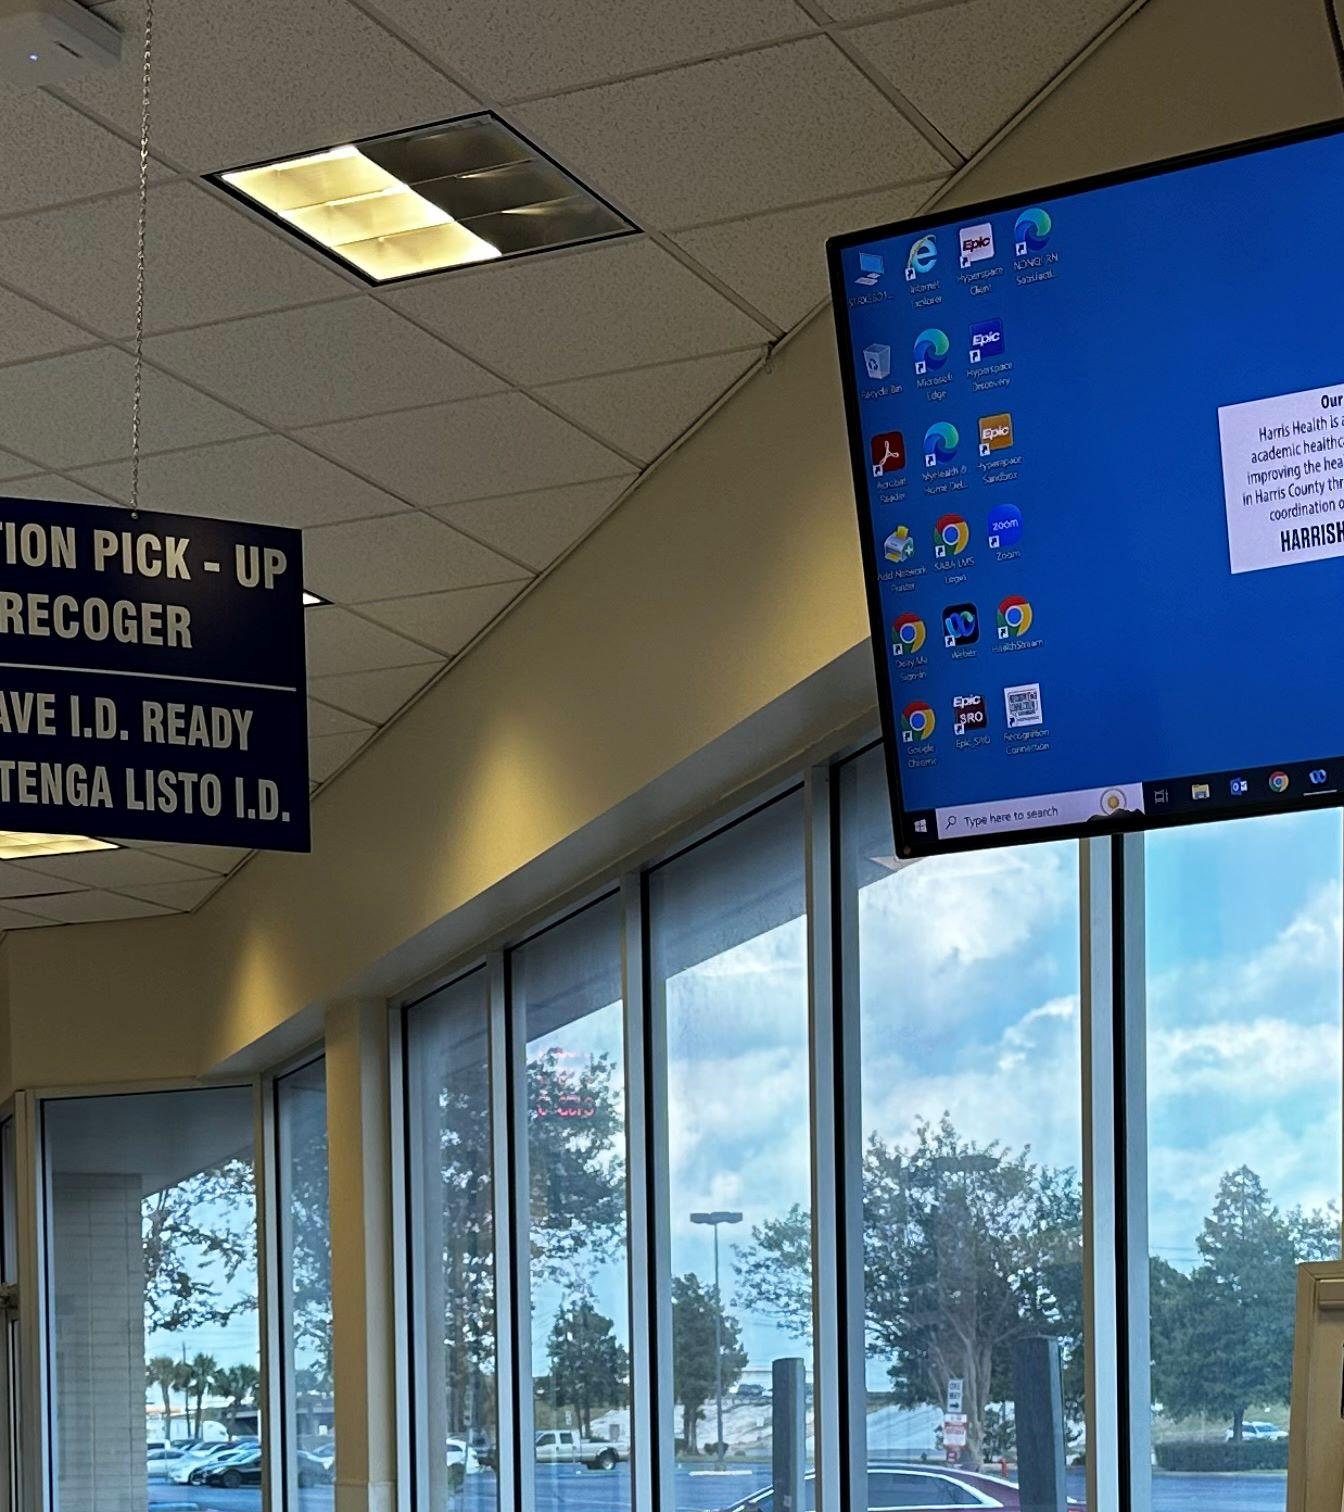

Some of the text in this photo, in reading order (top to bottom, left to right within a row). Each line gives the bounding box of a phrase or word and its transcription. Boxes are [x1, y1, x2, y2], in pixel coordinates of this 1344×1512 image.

[962, 236, 991, 252] Epic
[972, 330, 1001, 347] Epic
[1320, 394, 1344, 409] Our
[982, 425, 1010, 441] Epic
[1258, 424, 1291, 442] Harris
[1292, 416, 1328, 435] Health
[1329, 414, 1339, 429] is
[1251, 444, 1301, 464] academic
[1247, 465, 1301, 485] improving
[1303, 459, 1322, 475] the
[1242, 493, 1253, 506] in
[1255, 488, 1286, 504] Harris
[1288, 480, 1325, 498] County
[1269, 500, 1336, 522] coordination
[992, 518, 1019, 531] zoom
[94, 530, 190, 580] PICK
[235, 544, 287, 589] UP
[953, 694, 981, 709] Epic
[70, 695, 129, 741] I.D.
[142, 701, 252, 750] READY
[959, 711, 983, 724] SRO
[126, 768, 222, 816] LISTO
[235, 777, 290, 822] I.D.
[964, 806, 1058, 828] Type here to search
